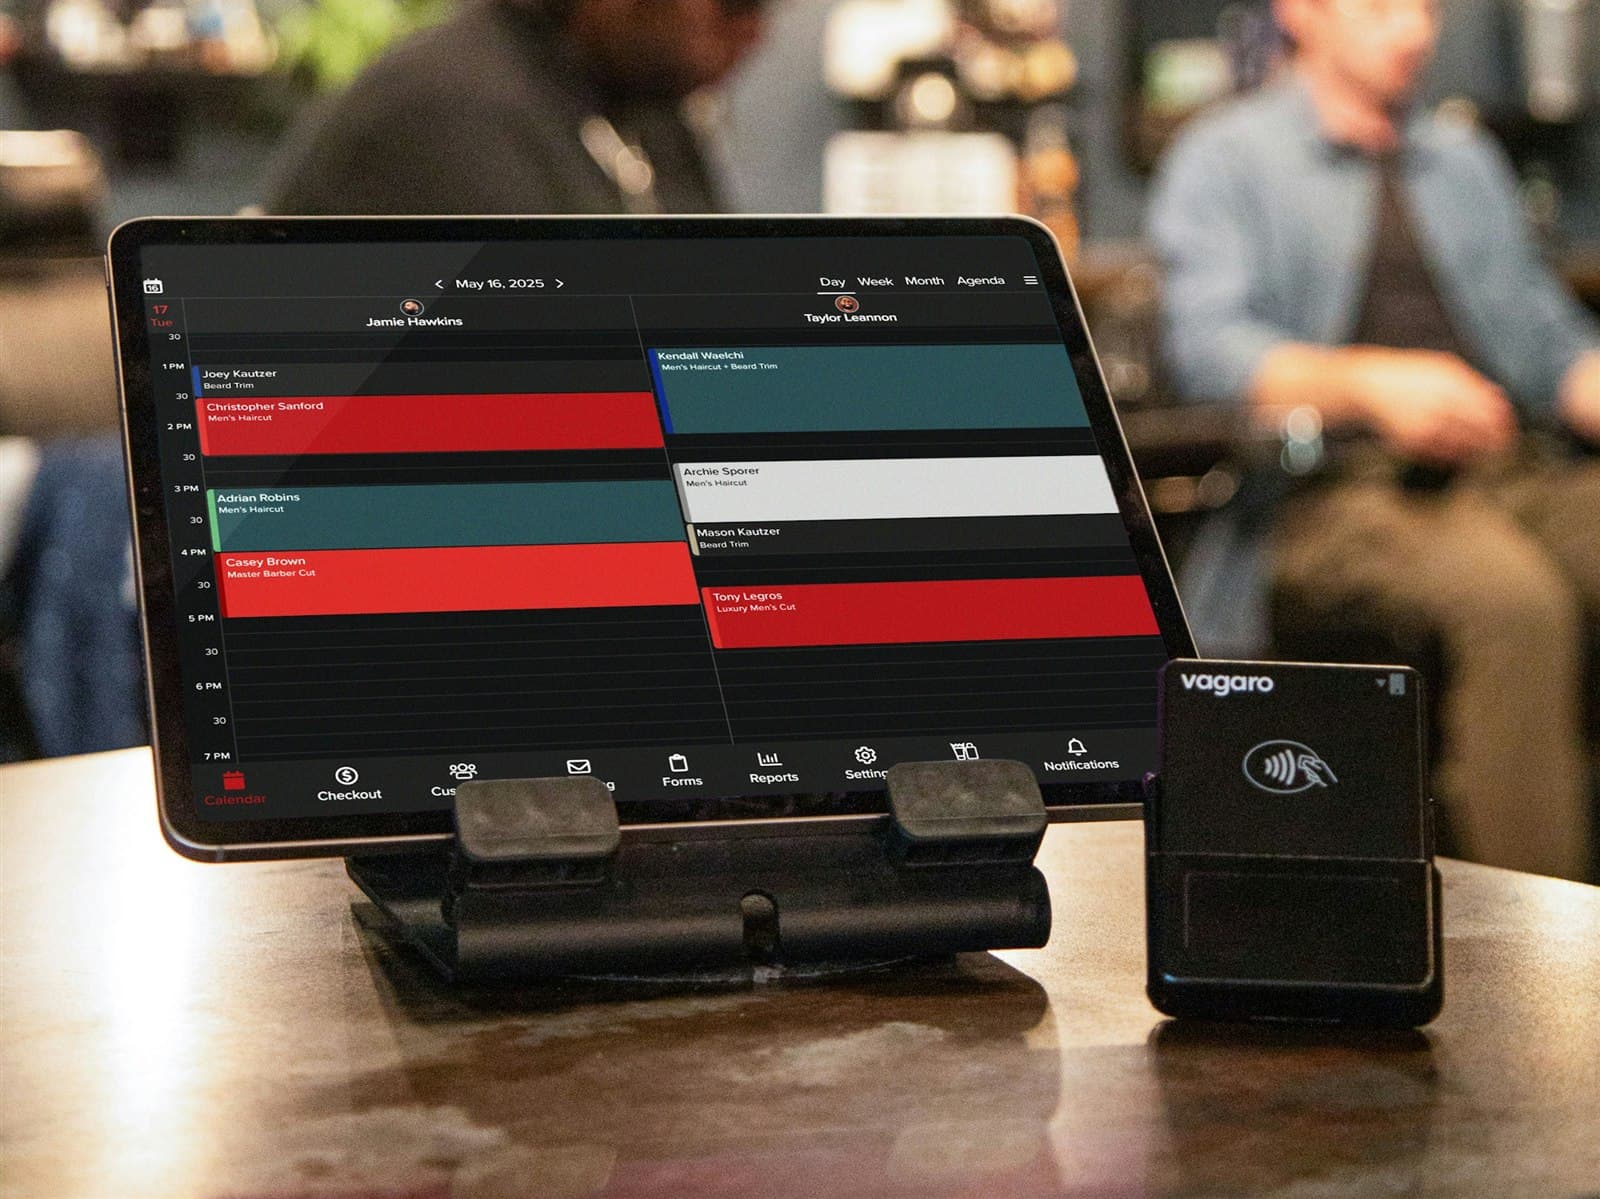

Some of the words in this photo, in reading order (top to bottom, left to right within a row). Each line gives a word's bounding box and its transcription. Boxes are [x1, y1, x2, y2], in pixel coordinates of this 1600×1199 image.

[455, 279, 484, 291] May
[487, 278, 506, 289] 16,
[508, 278, 545, 289] 2025
[819, 277, 846, 289] Day
[856, 277, 895, 287] Week
[904, 276, 945, 286] Month
[957, 276, 1006, 287] Agenda
[152, 304, 169, 315] 17
[150, 317, 174, 328] Tue
[365, 317, 405, 327] Jamie
[406, 315, 464, 327] Hawkins
[803, 313, 842, 324] Taylor
[843, 313, 898, 322] Leannon
[168, 333, 182, 341] 30
[657, 352, 699, 361] Kendall
[700, 351, 745, 360] Waelchi
[168, 362, 185, 370] PM
[661, 363, 689, 371] Men's
[689, 363, 722, 371] Haircut
[758, 362, 778, 370] Trim
[202, 370, 230, 380] Joey
[232, 369, 277, 378] Kautzer
[203, 382, 232, 390] Beard
[175, 392, 189, 400] 30
[206, 402, 275, 413] Christopher
[277, 401, 324, 411] Sanford
[207, 414, 236, 422] Men's
[238, 414, 273, 422] Haircut
[182, 453, 196, 461] 30
[683, 467, 720, 476] Archie
[721, 466, 760, 477] Sporer
[183, 484, 200, 492] PM
[685, 479, 713, 487] Men's
[714, 479, 748, 487] Haircut
[216, 494, 257, 503] Adrian
[259, 493, 301, 503] Robins
[218, 506, 248, 514] Men's
[249, 505, 285, 513] Haircut
[190, 516, 203, 524] 30
[696, 528, 736, 537] Mason
[737, 527, 780, 537] Kautzer
[699, 541, 728, 549] Beard
[729, 540, 750, 548] Trim
[190, 548, 207, 556] PM
[225, 558, 264, 569] Casey
[266, 557, 306, 567] Brown
[227, 570, 261, 579] Master
[262, 569, 296, 578] Barber
[297, 568, 316, 577] Cut
[197, 581, 211, 590] 30
[712, 592, 741, 603] Tony
[742, 592, 783, 602] Legros
[716, 605, 748, 614] Luxury
[749, 603, 778, 612] Men's
[778, 603, 797, 611] Cut
[197, 614, 215, 622] PM
[205, 647, 219, 656] 30
[205, 682, 222, 690] PM
[1180, 673, 1274, 697] vagaro
[212, 716, 227, 725] 30
[213, 752, 231, 760] PM
[1043, 757, 1120, 771] Notifications
[749, 772, 800, 785] Reports
[844, 768, 889, 780] Setting
[662, 776, 704, 787] Forms
[203, 793, 267, 806] Calendar
[317, 789, 383, 801] Checkout
